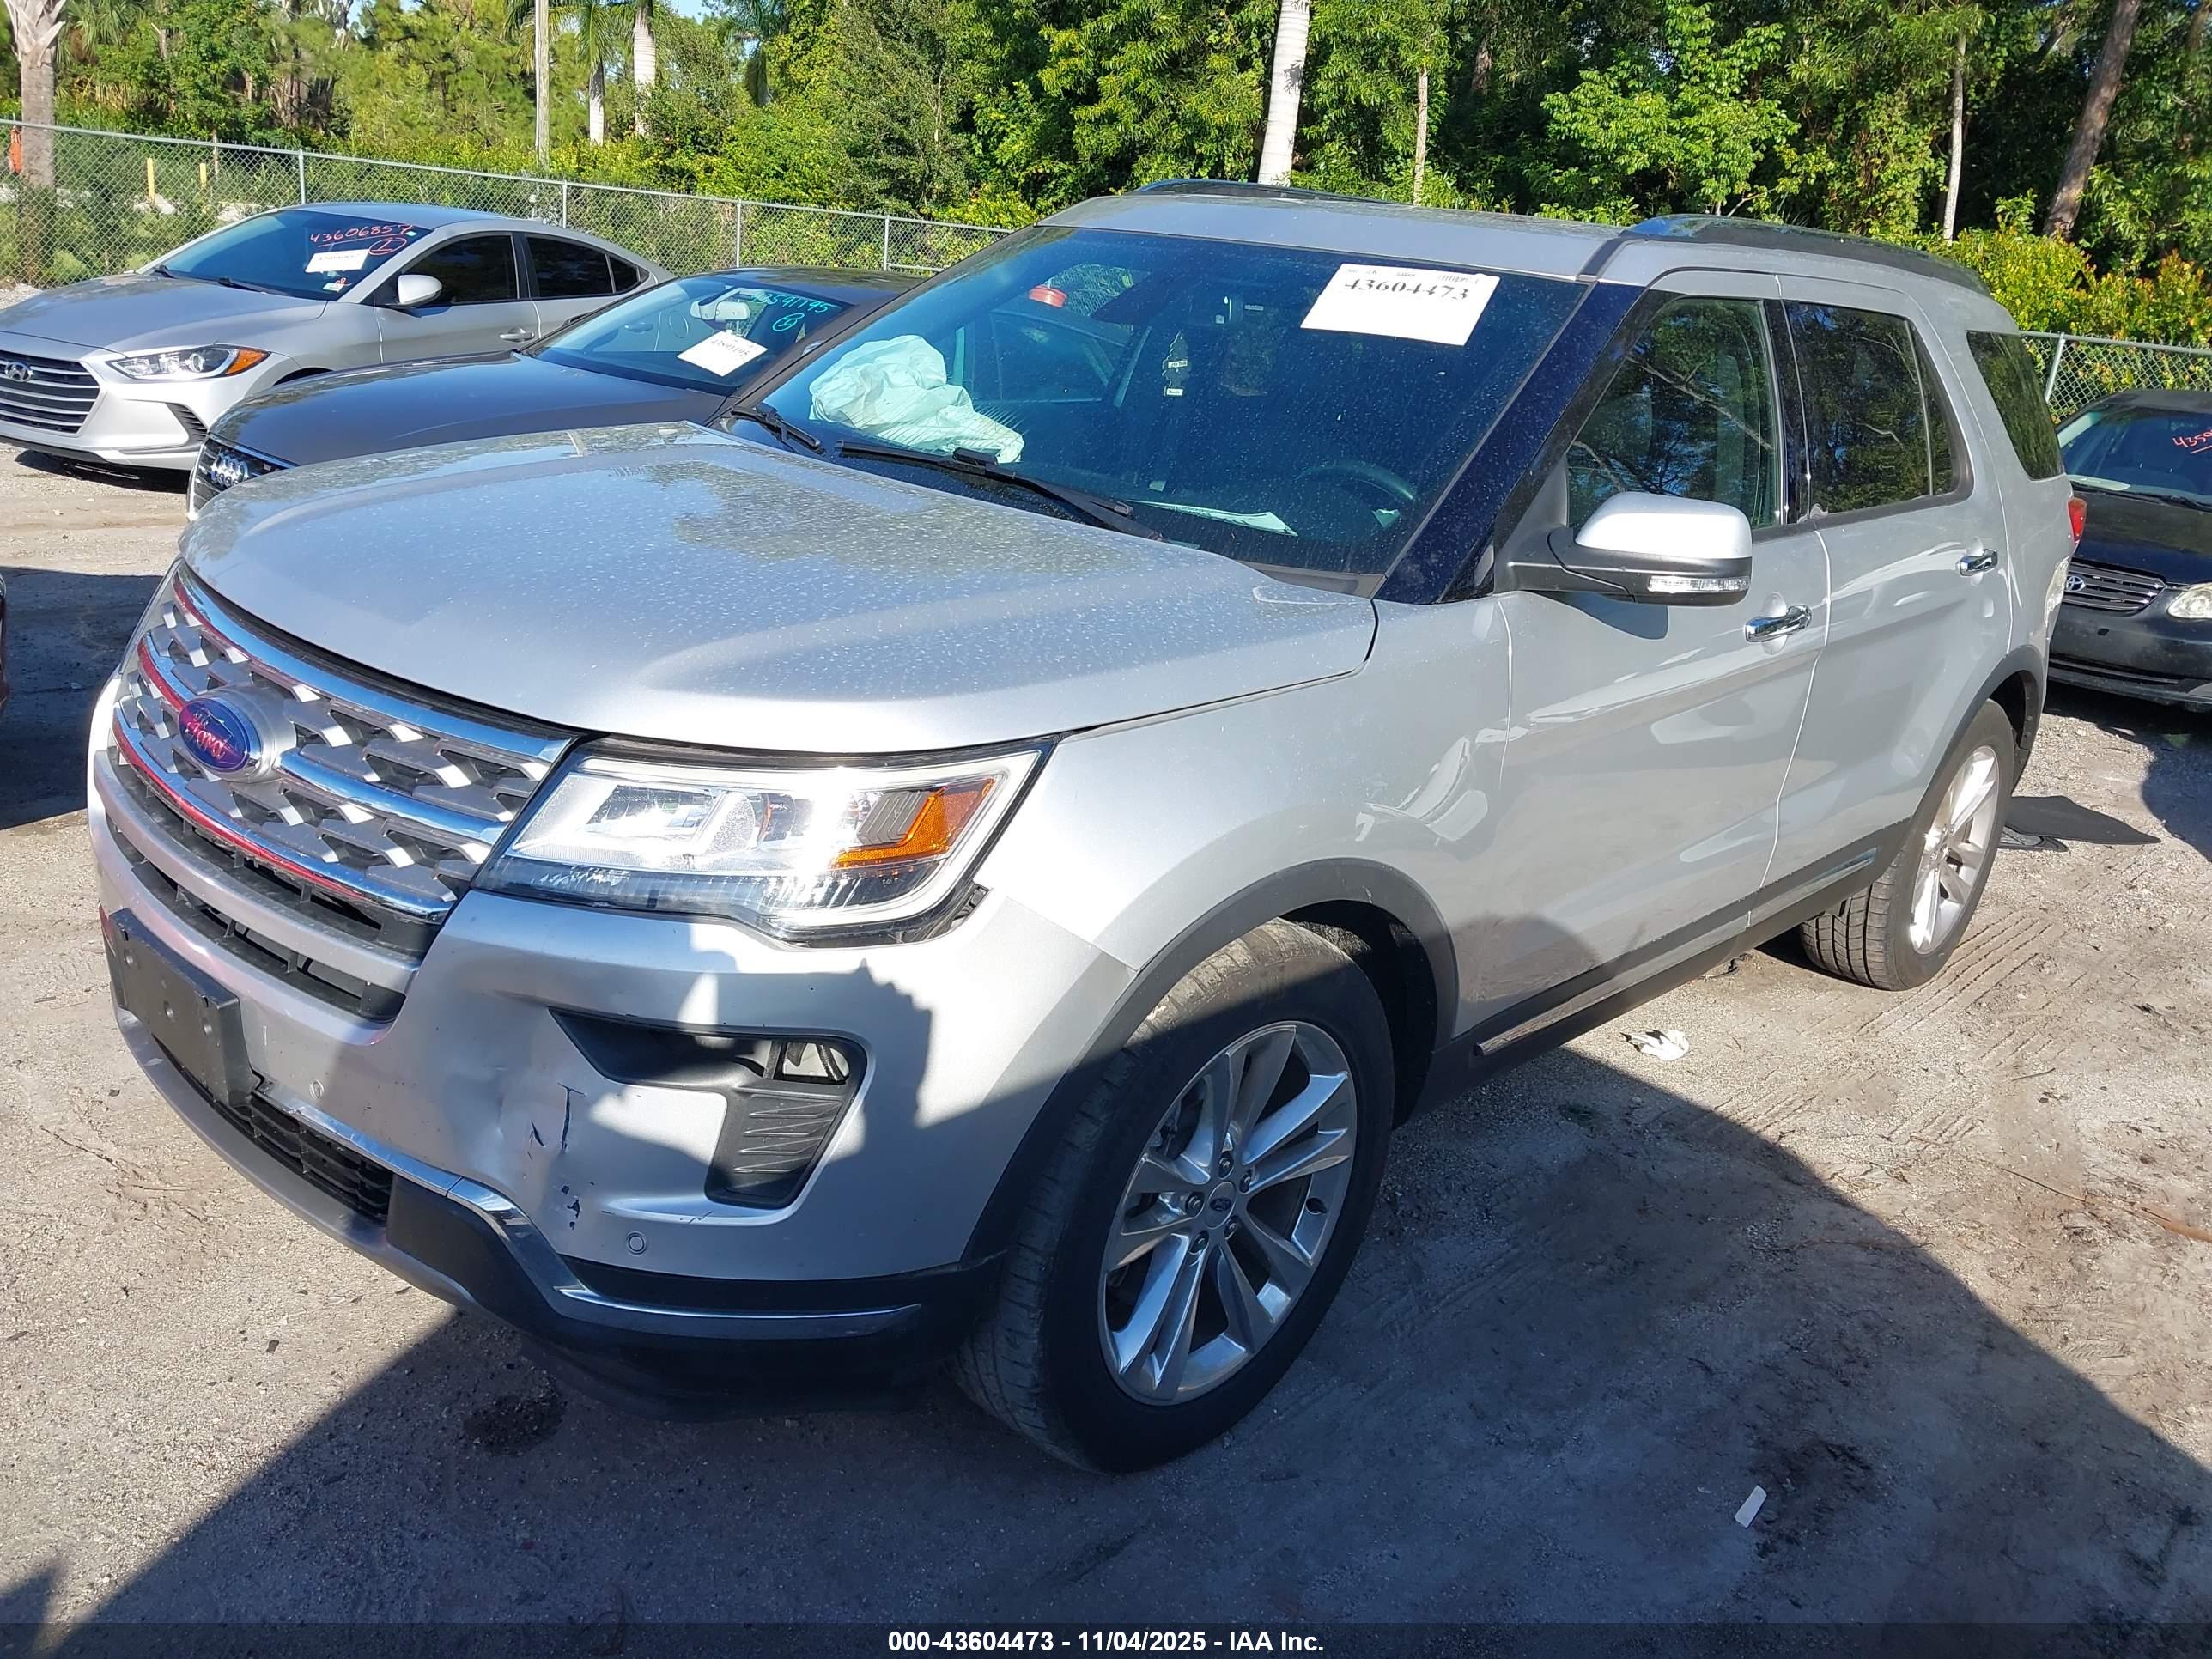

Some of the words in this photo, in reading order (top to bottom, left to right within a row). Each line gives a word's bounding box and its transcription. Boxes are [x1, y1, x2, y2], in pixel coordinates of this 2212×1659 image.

[310, 224, 414, 243] 43606857
[1344, 278, 1469, 300] 43604473
[750, 292, 832, 313] 43591195
